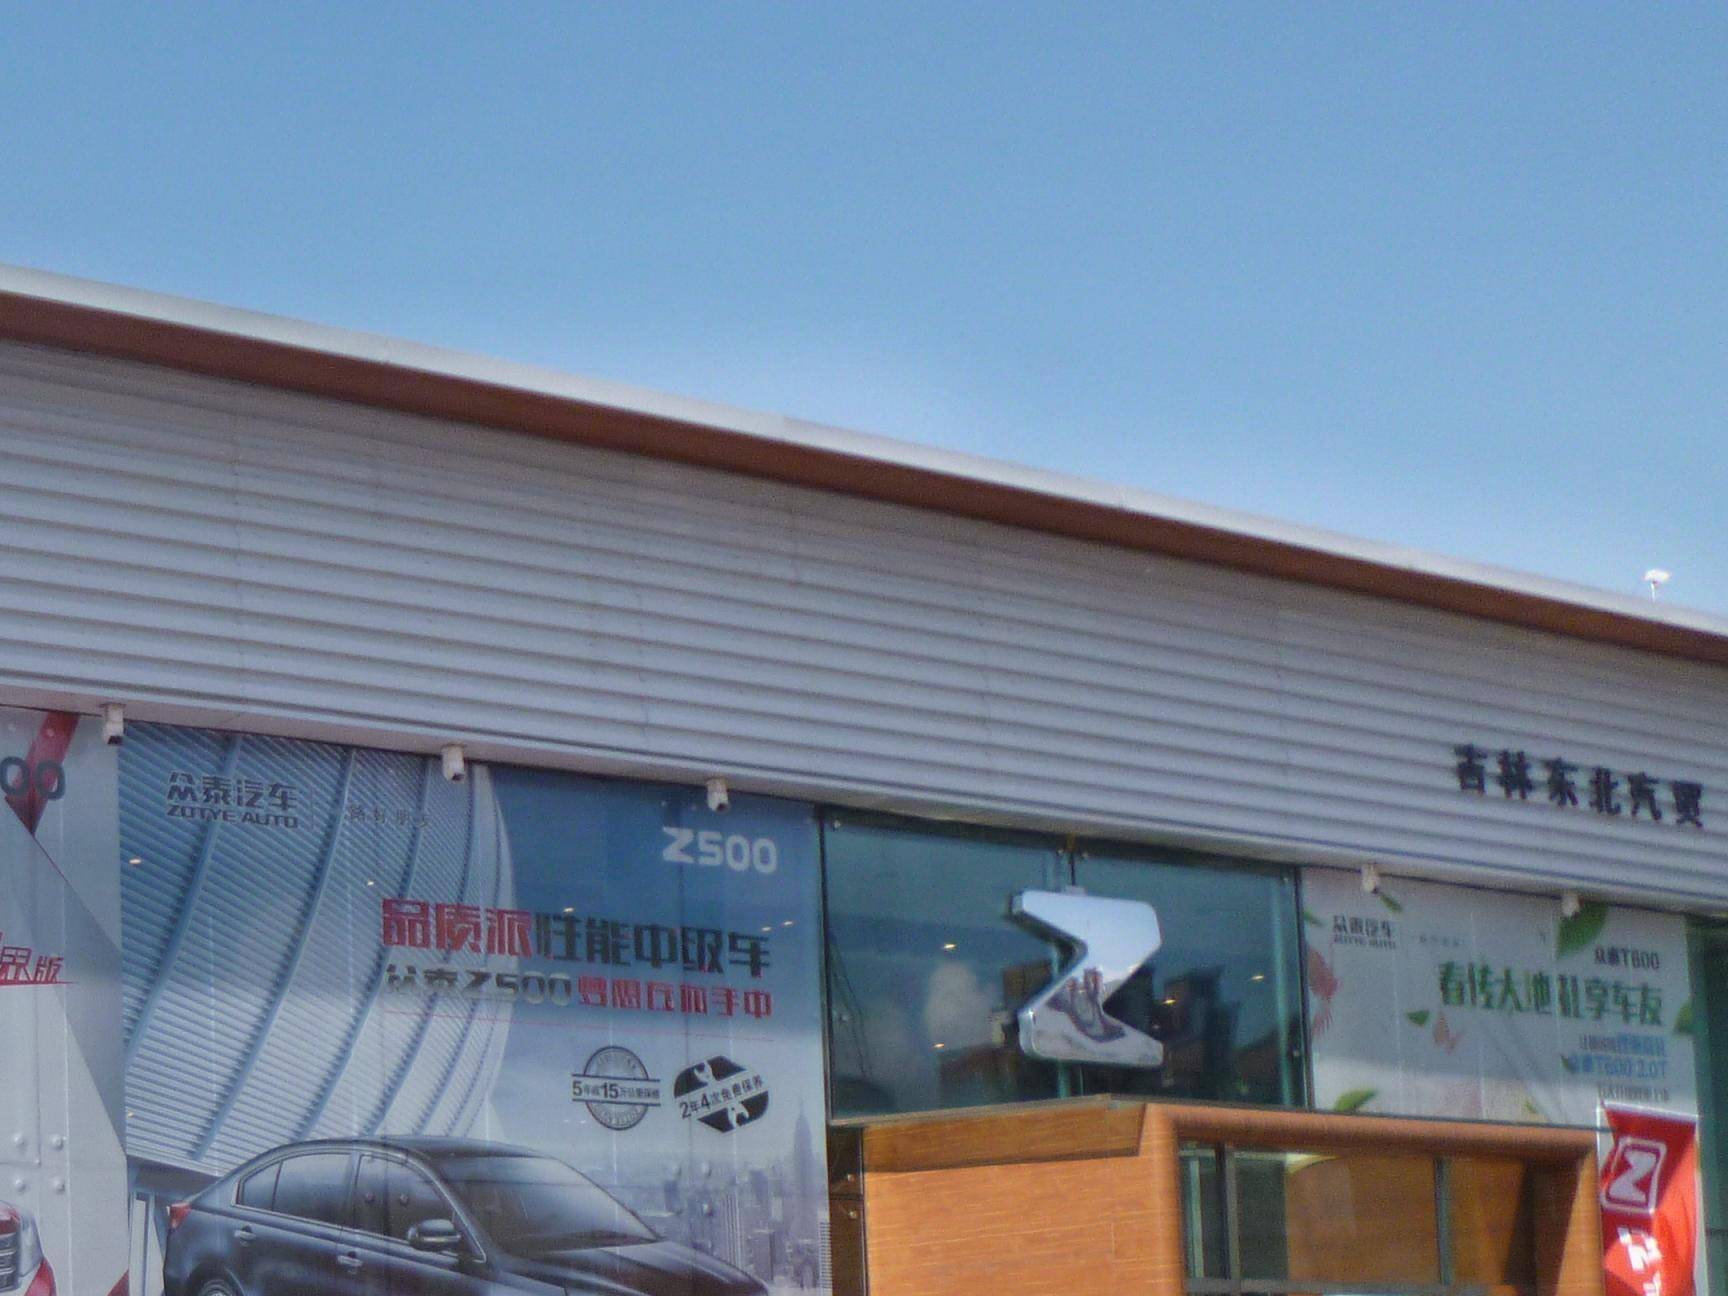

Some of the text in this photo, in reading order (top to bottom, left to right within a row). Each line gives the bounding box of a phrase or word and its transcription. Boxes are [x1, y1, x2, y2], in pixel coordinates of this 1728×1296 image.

[167, 772, 297, 810] 众泰汽车
[167, 804, 298, 829] ZOTYE AUTO
[663, 826, 777, 873] Z500
[382, 897, 770, 978] 品质派 性能中级车
